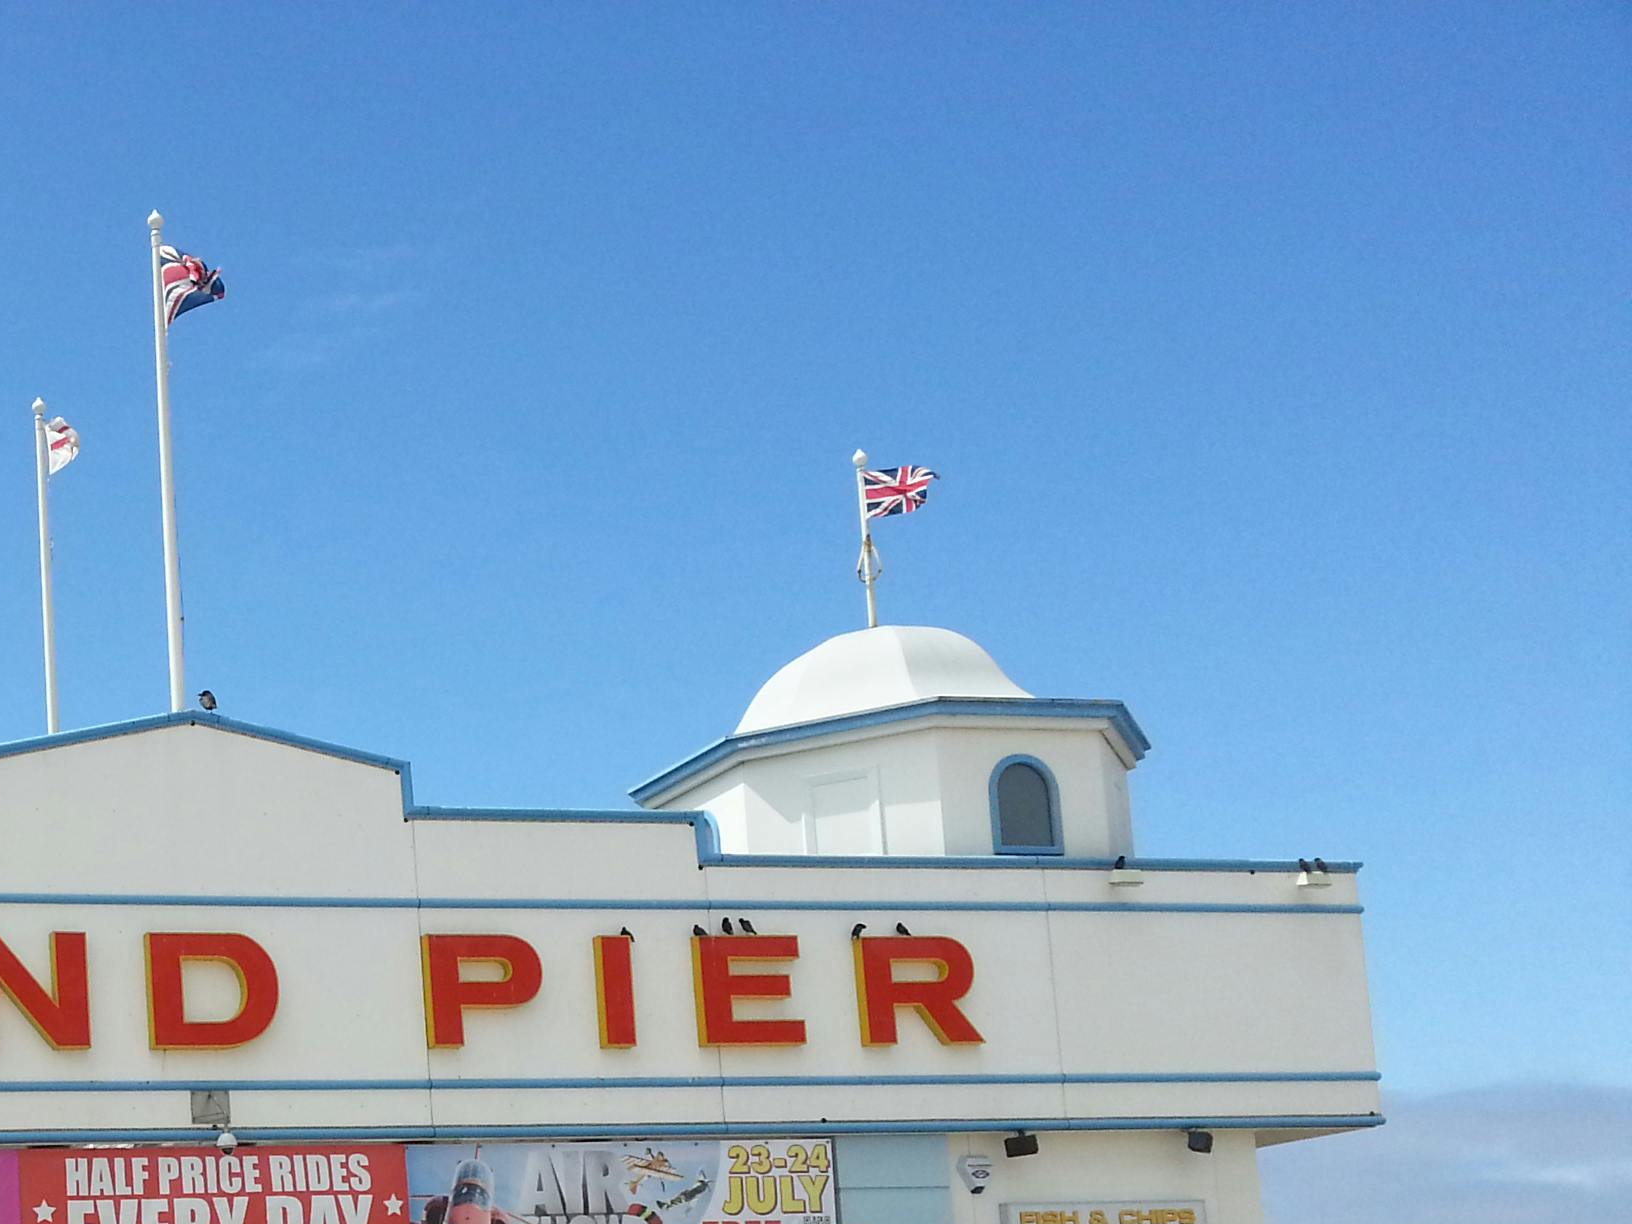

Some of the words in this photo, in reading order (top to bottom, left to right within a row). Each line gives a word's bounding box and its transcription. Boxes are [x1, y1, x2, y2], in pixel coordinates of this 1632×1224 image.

[421, 932, 986, 1050] PIER
[65, 1157, 149, 1196] HALF
[158, 1154, 263, 1195] PRICE
[269, 1153, 372, 1191] RIDES
[728, 1144, 831, 1174] 23-24
[520, 1150, 629, 1215] AIR
[722, 1174, 830, 1215] JULY
